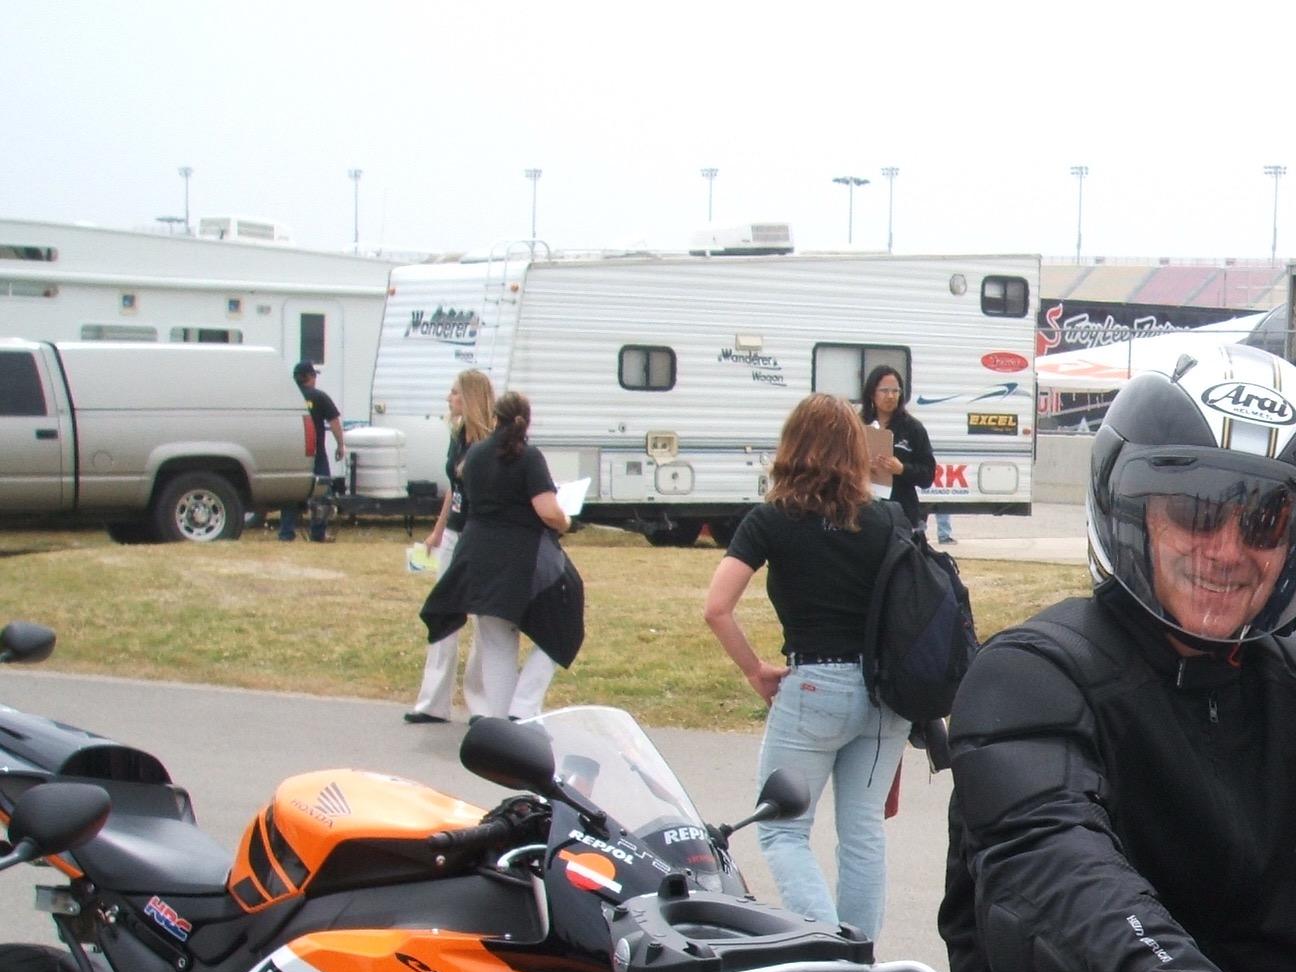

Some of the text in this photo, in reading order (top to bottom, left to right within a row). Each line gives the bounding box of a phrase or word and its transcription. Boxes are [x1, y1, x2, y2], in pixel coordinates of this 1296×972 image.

[404, 310, 470, 339] Wanderer
[718, 347, 773, 366] Wanderer
[752, 371, 784, 384] Wagon
[1207, 384, 1288, 417] Arai
[969, 414, 1017, 426] EXCEL
[568, 829, 635, 865] REPSOL
[144, 895, 193, 942] HRC
